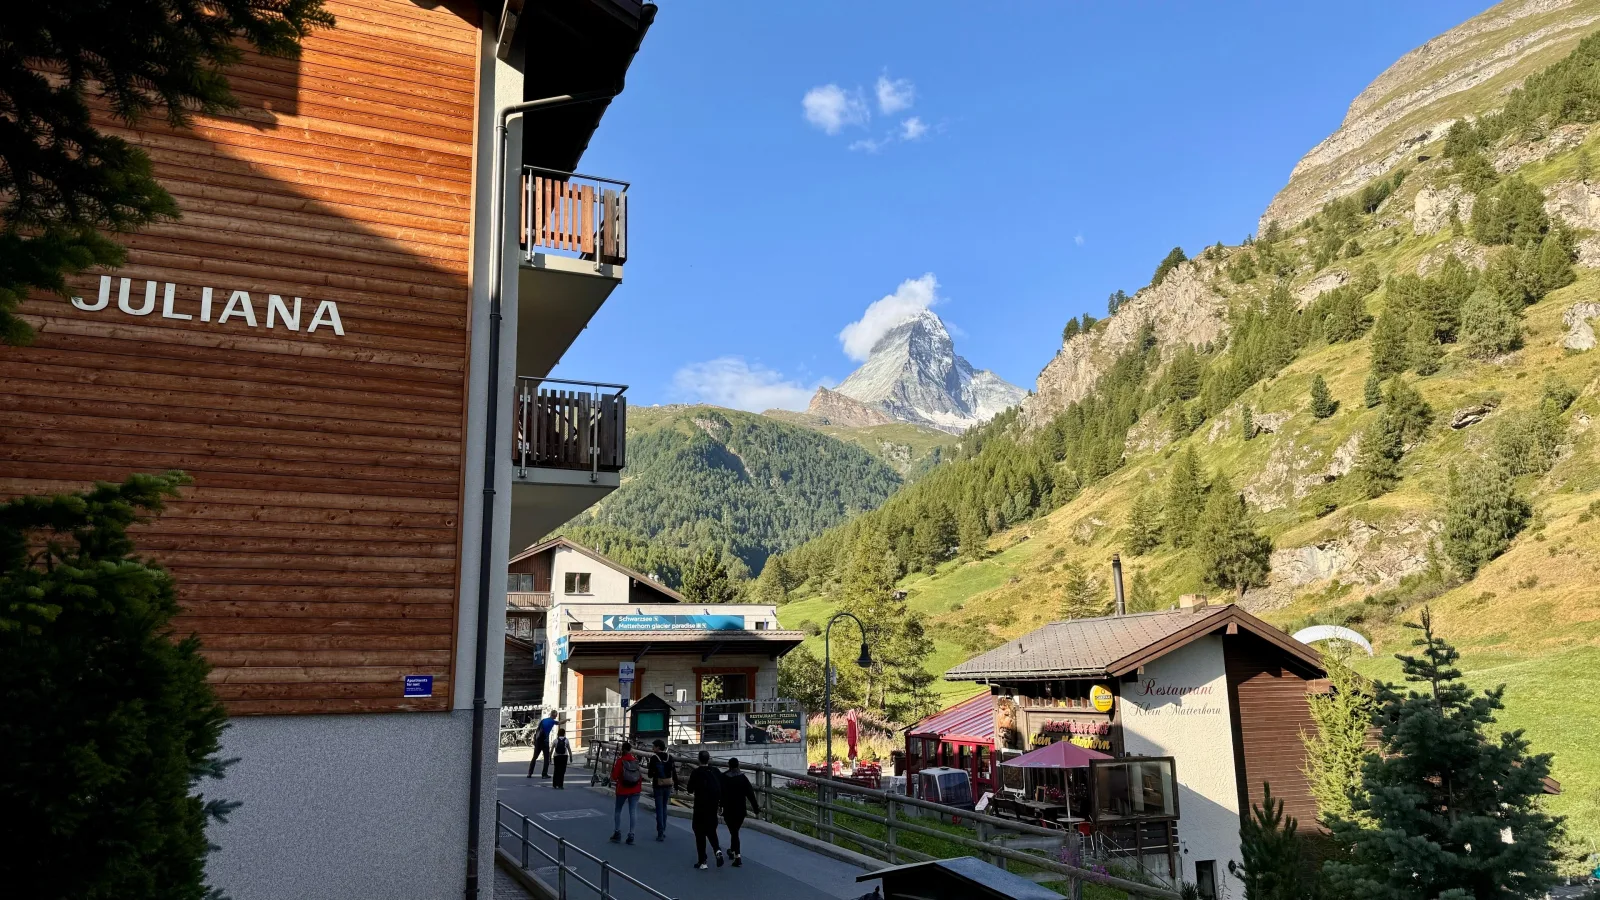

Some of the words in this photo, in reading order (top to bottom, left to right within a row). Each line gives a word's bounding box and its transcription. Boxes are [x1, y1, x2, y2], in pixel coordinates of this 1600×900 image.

[70, 275, 345, 336] JULIANA
[651, 623, 670, 631] glacier
[671, 623, 696, 631] paradise
[1135, 677, 1214, 696] Restaurant
[1129, 701, 1161, 717] Klein
[1166, 702, 1221, 716] Matterhorn
[1029, 733, 1052, 746] Klein
